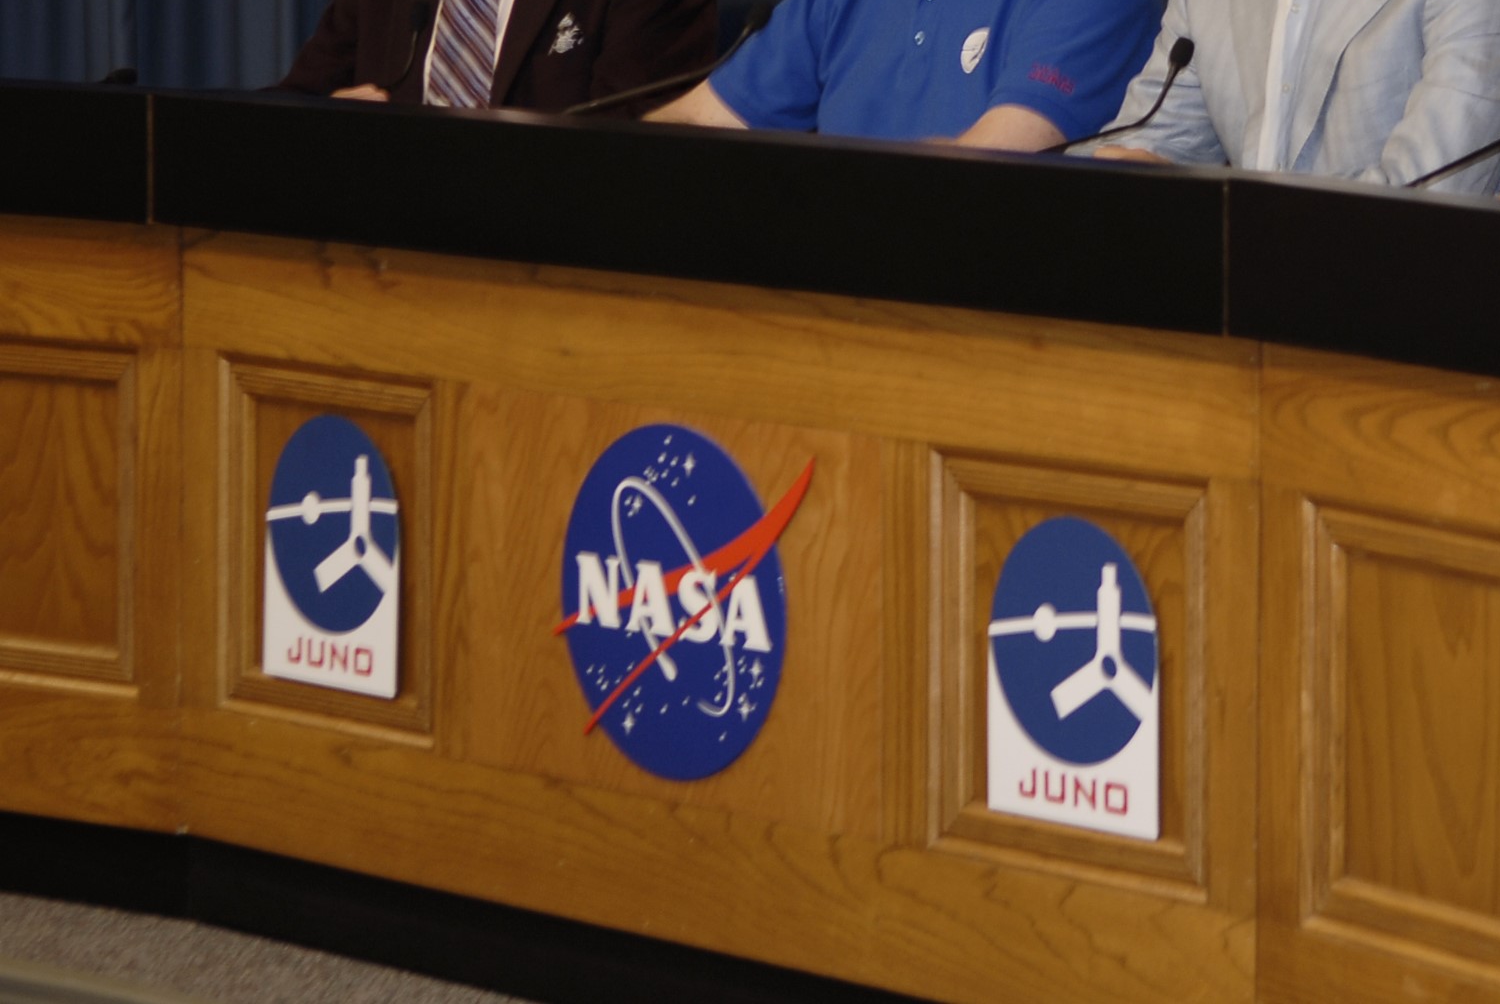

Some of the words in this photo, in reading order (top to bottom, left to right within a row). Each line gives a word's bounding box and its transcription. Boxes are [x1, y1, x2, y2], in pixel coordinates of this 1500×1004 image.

[575, 550, 772, 653] NASA
[287, 636, 374, 678] JUNO
[1017, 767, 1130, 816] JUNO
